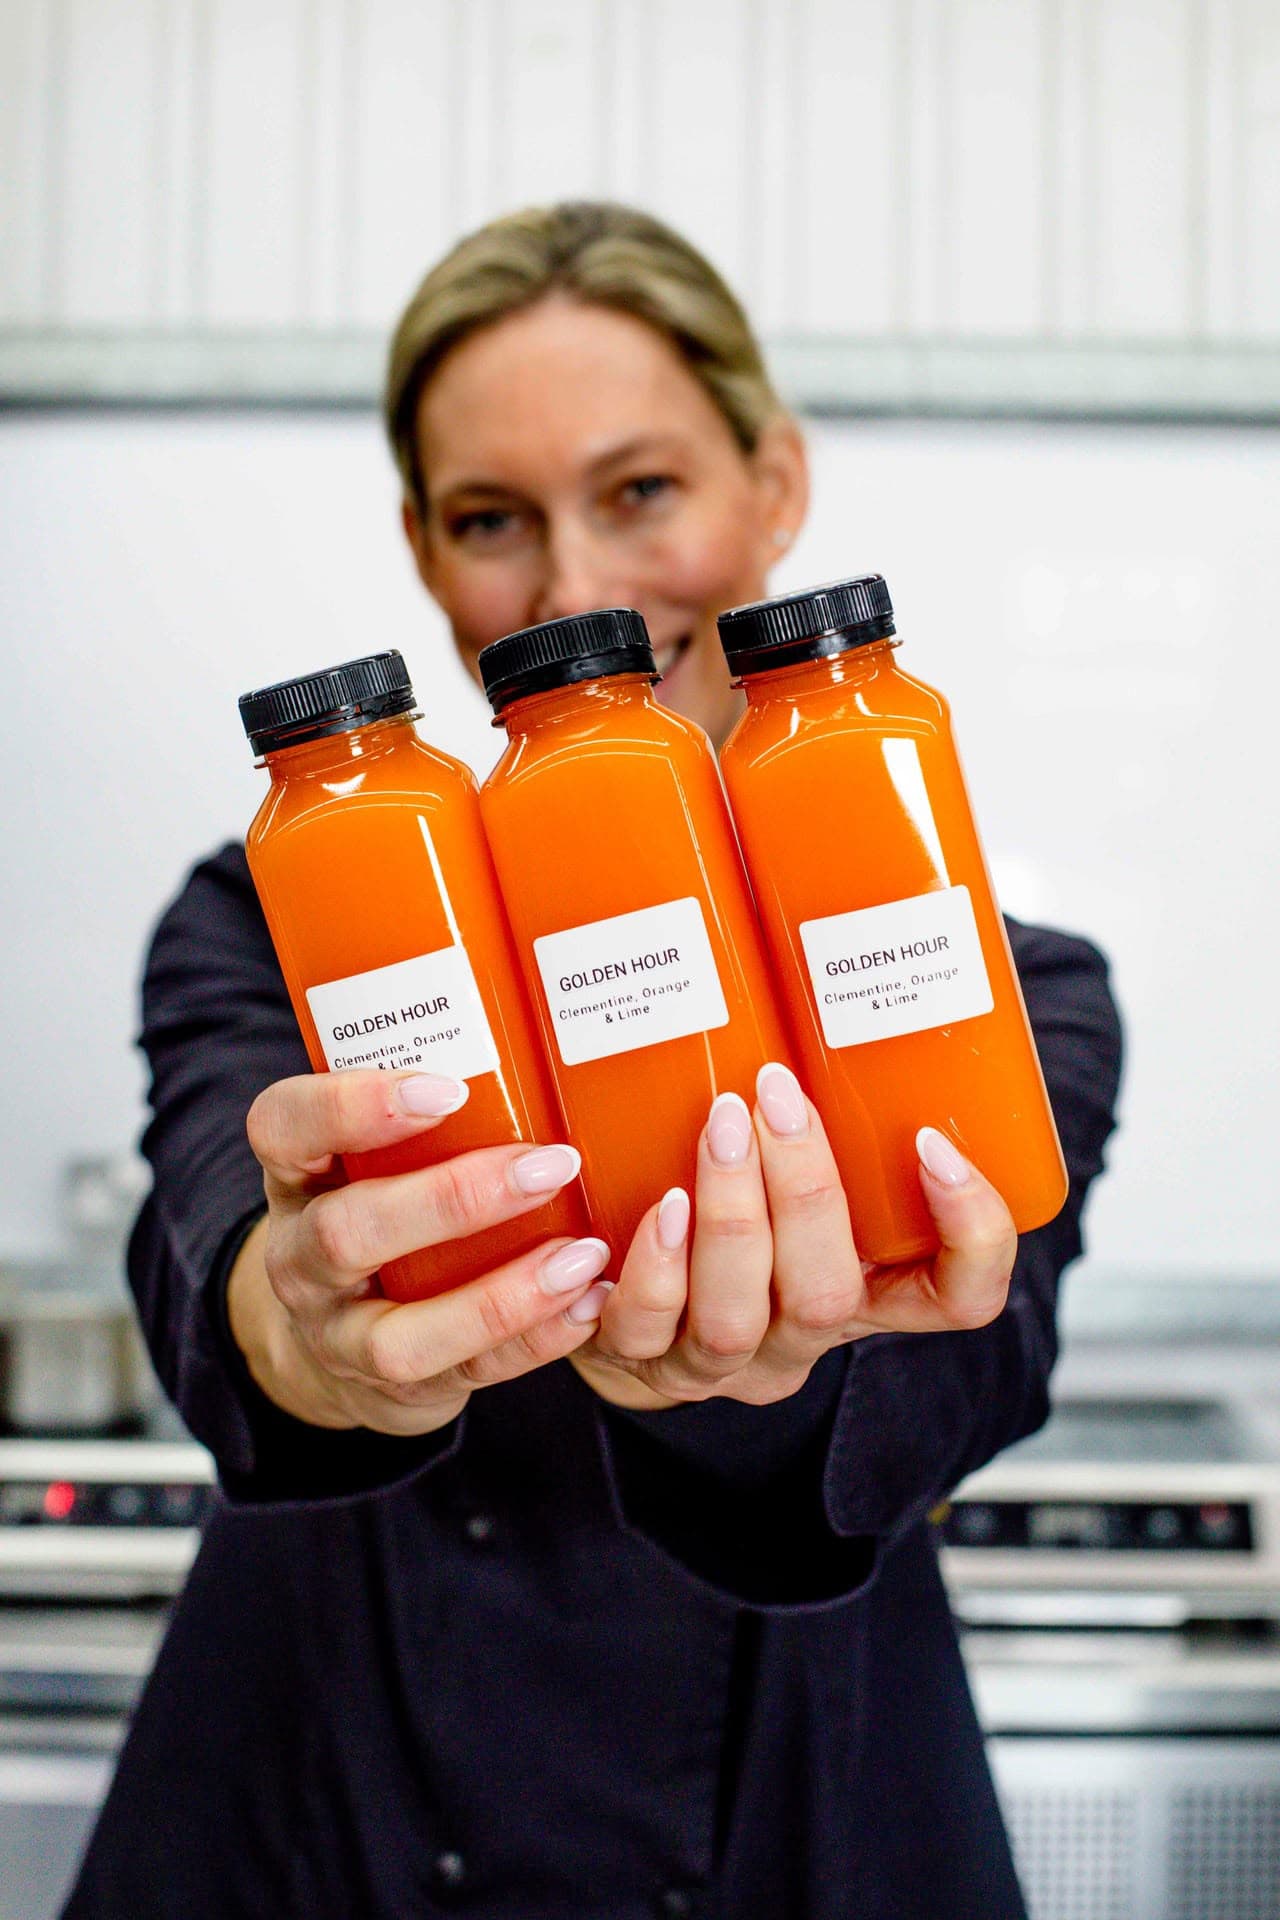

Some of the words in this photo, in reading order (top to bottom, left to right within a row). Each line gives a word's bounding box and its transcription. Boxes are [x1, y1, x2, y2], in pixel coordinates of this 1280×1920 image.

[559, 961, 627, 992] GOLDEN
[630, 947, 681, 973] HOUR
[825, 948, 896, 977] GOLDEN
[900, 935, 950, 961] HOUR
[559, 994, 638, 1021] Clementine,
[642, 978, 690, 998] Orange
[824, 981, 906, 1005] Clementine,
[911, 966, 959, 986] Orange
[871, 999, 880, 1010] &
[885, 991, 919, 1008] Lime
[332, 1011, 398, 1041] GOLDEN
[401, 996, 450, 1023] HOUR
[605, 1013, 613, 1024] &
[618, 1004, 651, 1021] Lime
[334, 1043, 410, 1069] Clementine,
[413, 1026, 461, 1047] Orange
[378, 1062, 386, 1070] &
[390, 1054, 423, 1070] Lime
